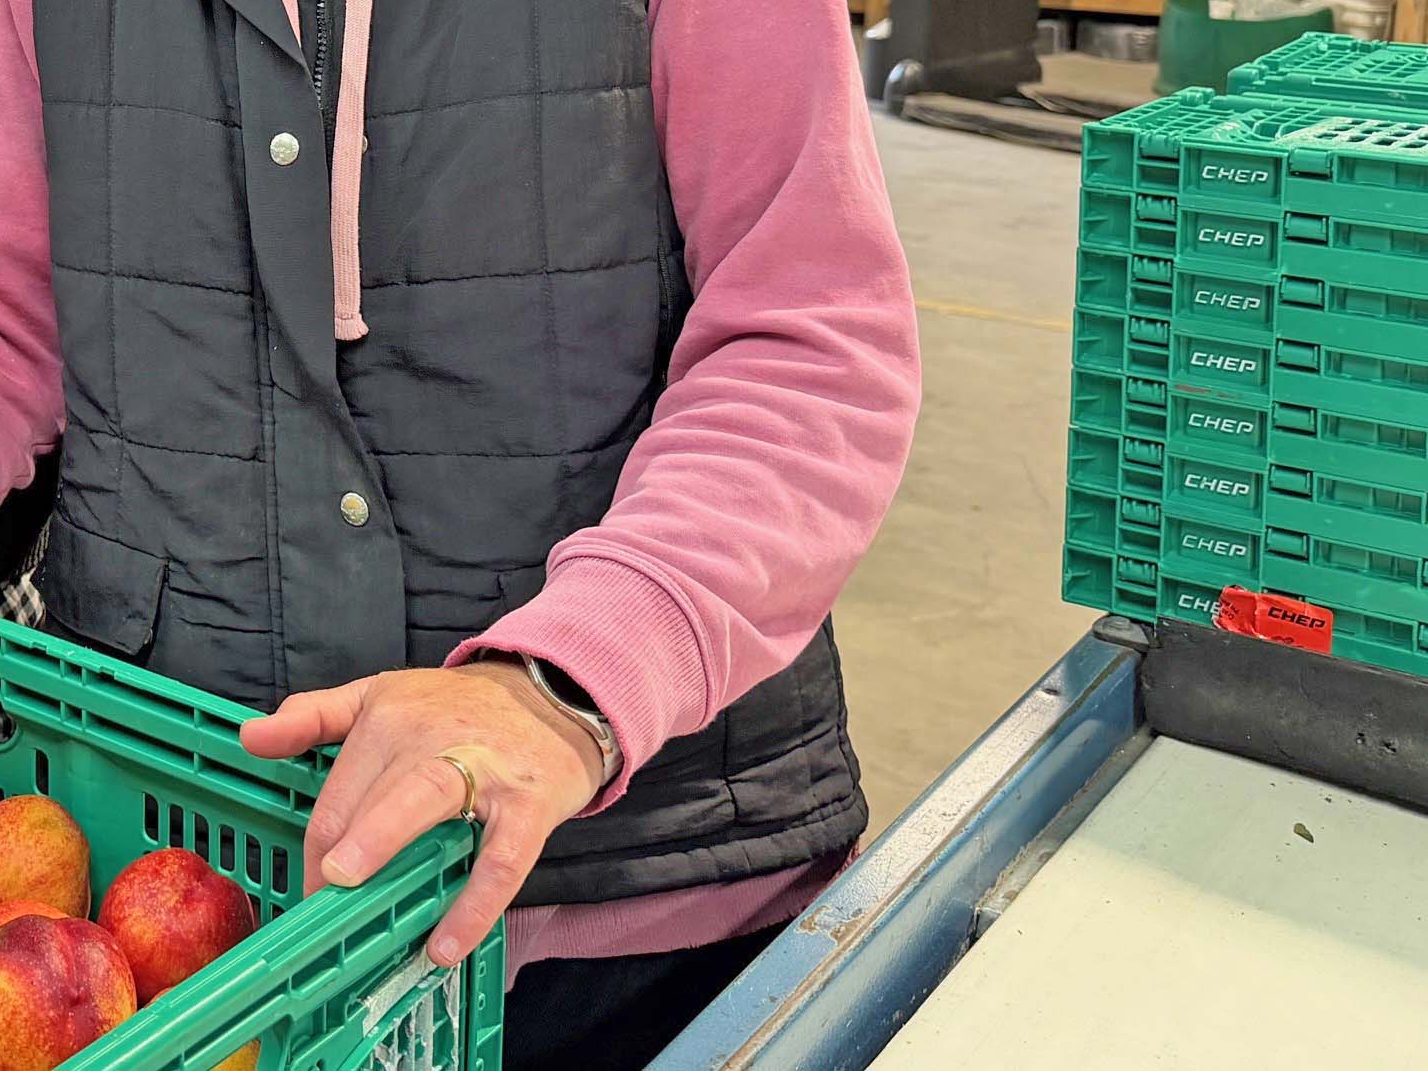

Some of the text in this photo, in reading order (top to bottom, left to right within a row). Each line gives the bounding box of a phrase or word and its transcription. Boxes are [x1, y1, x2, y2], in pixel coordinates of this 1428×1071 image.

[1201, 165, 1269, 183] CHEP
[1198, 228, 1264, 247] CHEP
[1194, 290, 1261, 311] CHEP
[1190, 352, 1257, 372] CHEP
[1188, 413, 1254, 433] CHEP
[1184, 473, 1250, 495] CHEP
[1181, 534, 1247, 557] CHEP
[1178, 594, 1222, 614] CHE
[1267, 606, 1326, 629] CHEP
